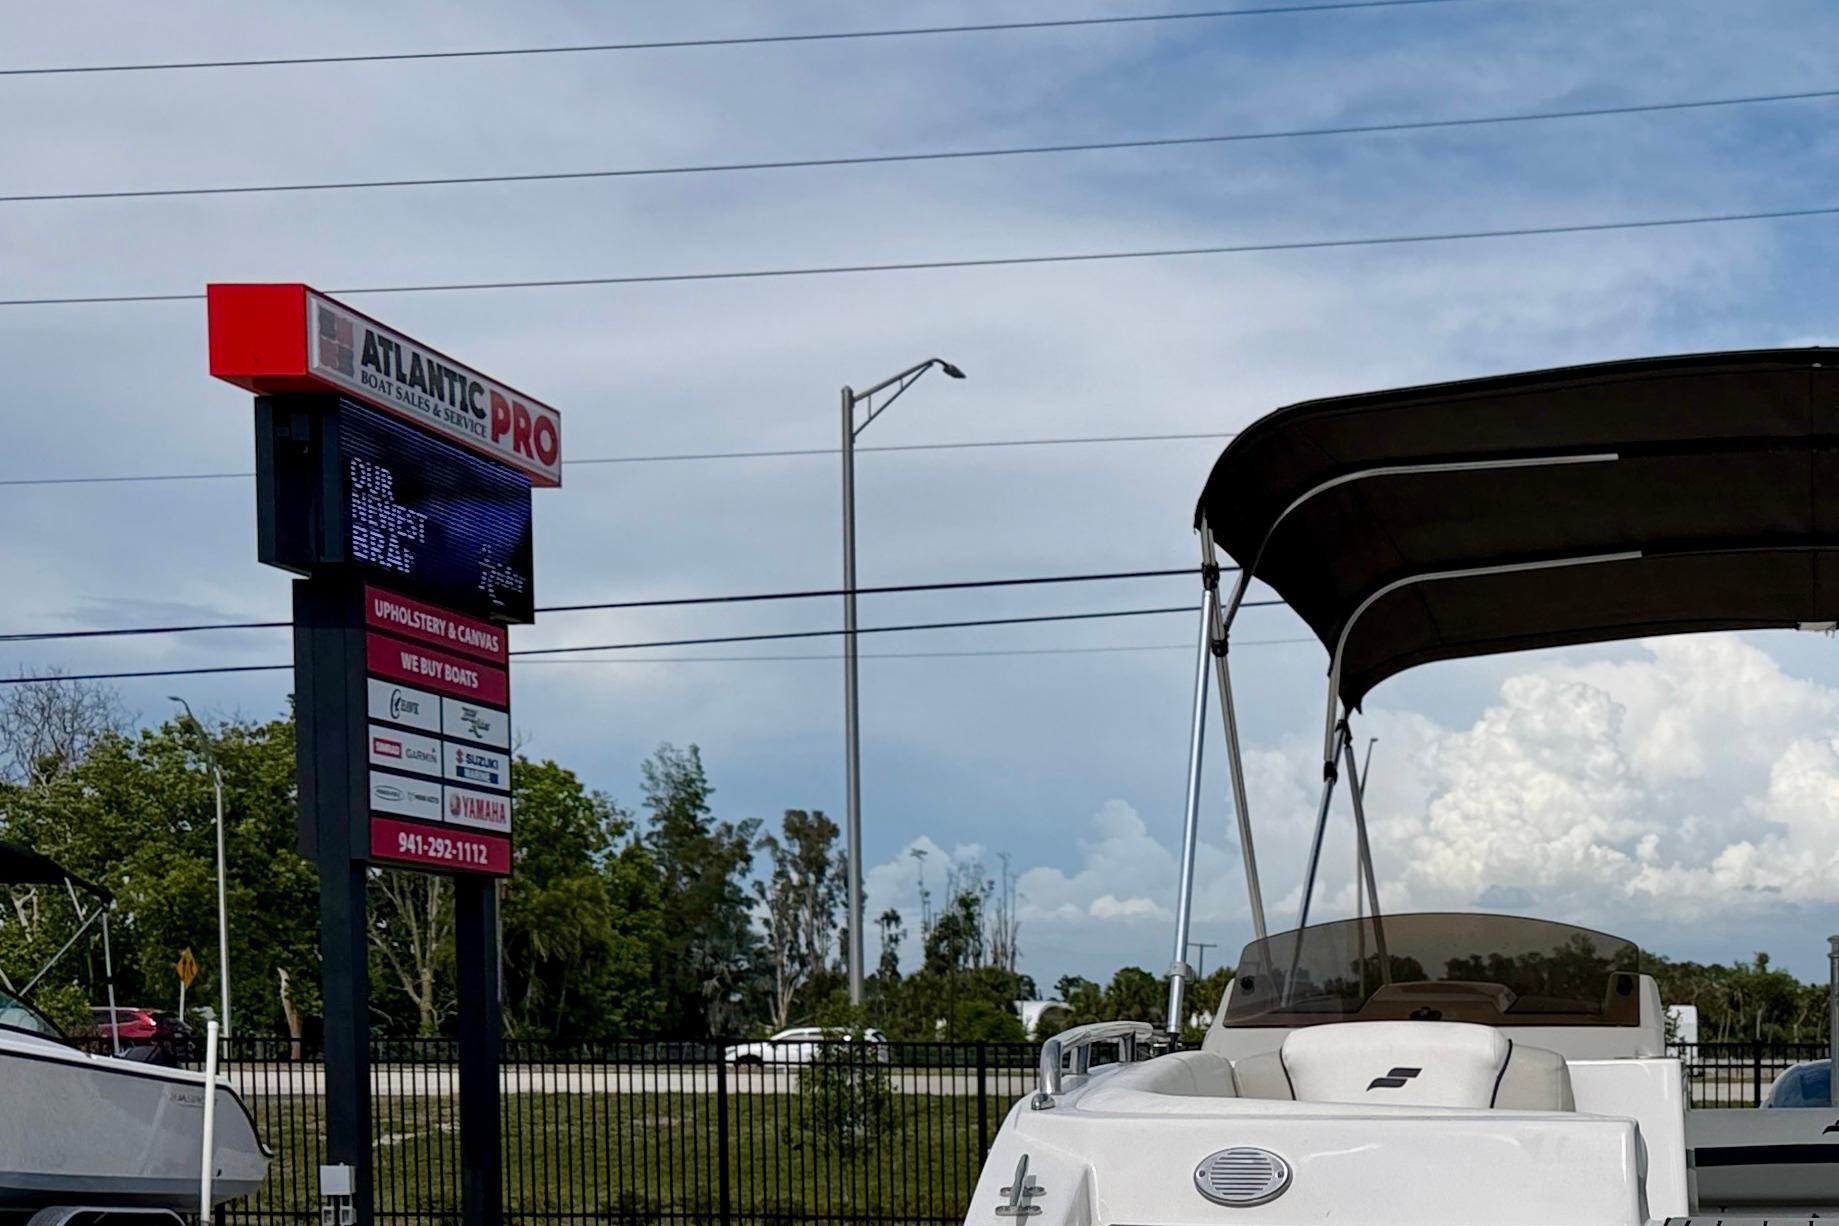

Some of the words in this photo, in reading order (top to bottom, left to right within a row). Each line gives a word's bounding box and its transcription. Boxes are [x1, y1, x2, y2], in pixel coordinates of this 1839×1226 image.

[361, 329, 487, 420] ATLANTIC
[490, 388, 559, 466] PRO
[361, 370, 394, 396] BOAT
[396, 387, 431, 413] SALES
[433, 403, 442, 418] &
[443, 408, 487, 439] SERVICE
[351, 457, 394, 501] OUR
[352, 491, 428, 544] NEWEST
[374, 598, 446, 637] UPHOLSTERY
[447, 622, 456, 640] &
[457, 625, 499, 653] CANVAS
[400, 651, 419, 673] WE
[420, 656, 443, 678] BUY
[444, 664, 479, 689] BOATS
[465, 753, 498, 770] SUZUKI
[462, 796, 507, 825] YAMAHA
[398, 831, 488, 864] 941-292-1112
